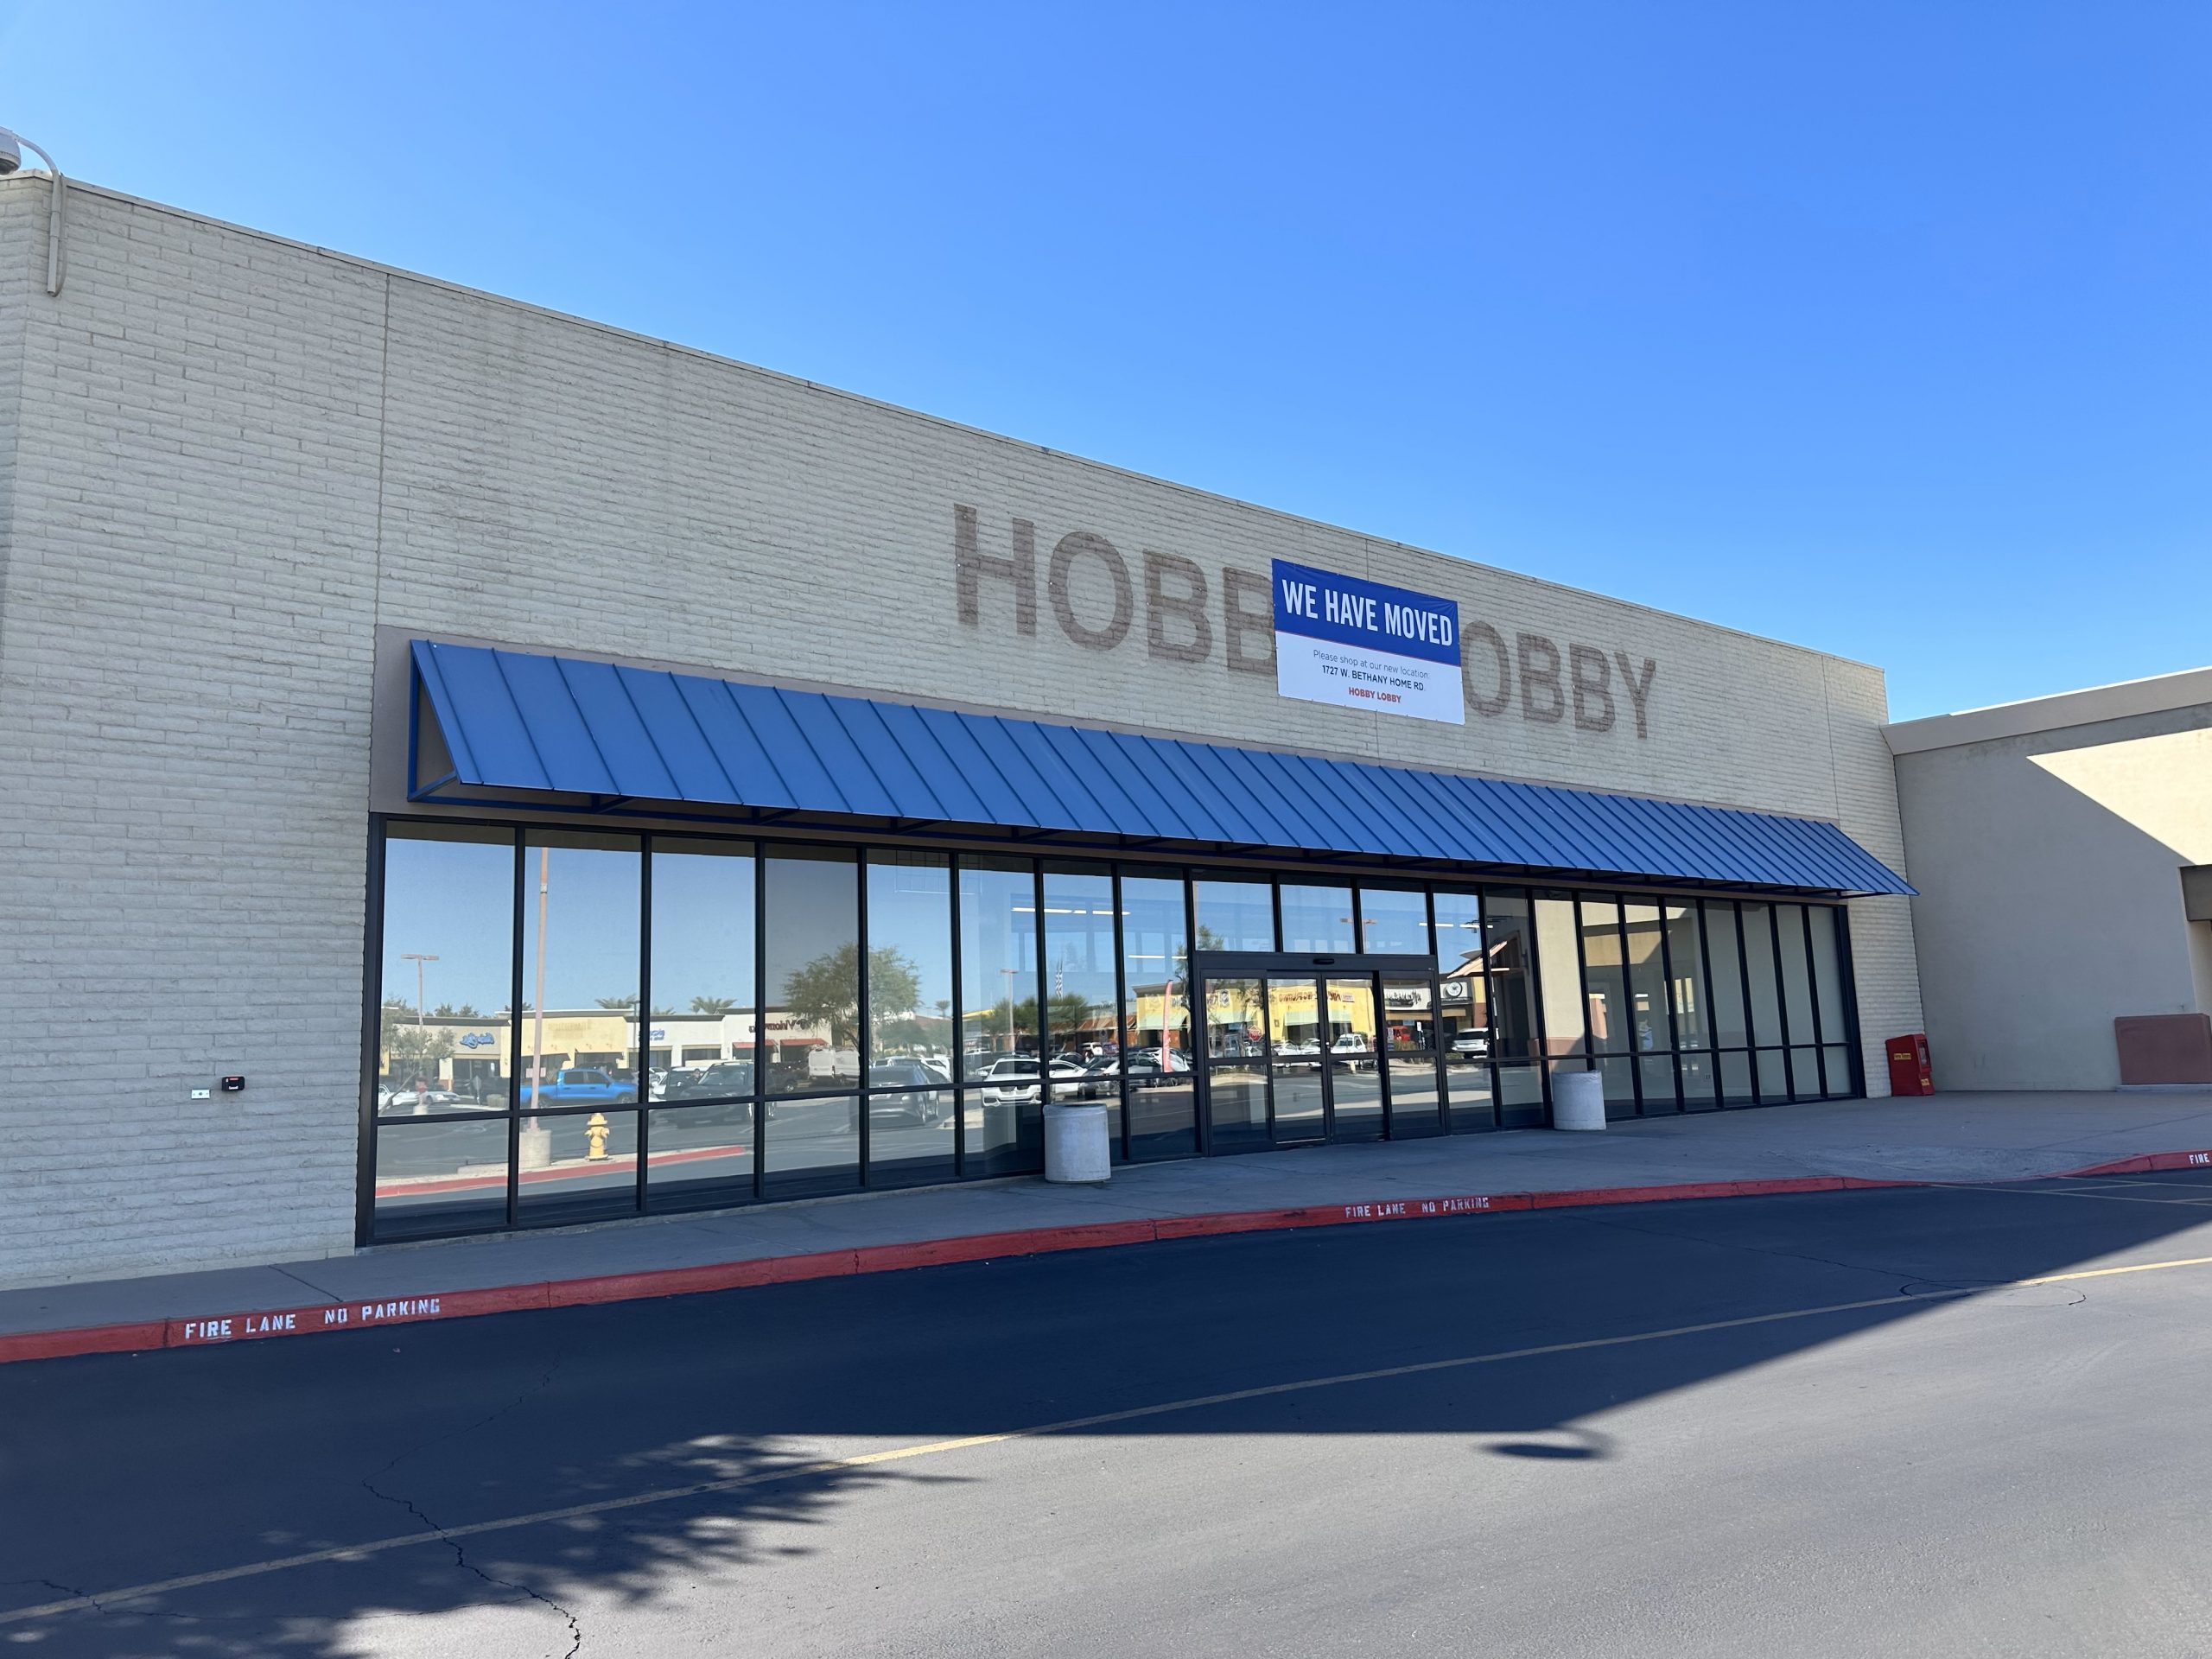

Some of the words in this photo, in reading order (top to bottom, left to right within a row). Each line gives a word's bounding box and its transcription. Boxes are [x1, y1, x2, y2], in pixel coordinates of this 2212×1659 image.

[954, 503, 1276, 675] HOBB
[1460, 620, 1656, 740] OBBY
[1281, 579, 1319, 620] WE
[1325, 588, 1378, 632] HAVE
[1384, 602, 1452, 646] MOVED
[1313, 650, 1338, 663] Please
[1339, 656, 1358, 667] shop
[1360, 659, 1368, 669] at
[1369, 662, 1382, 671] our
[1383, 664, 1399, 674] new
[1322, 664, 1338, 676] 1727
[1340, 668, 1350, 678] W.
[1351, 670, 1388, 685] BETHANY
[1389, 677, 1412, 690] HOME
[1348, 686, 1376, 699] HOBBY
[1376, 691, 1402, 703] LOBBY
[2189, 1154, 2210, 1164] FIRE
[1345, 1205, 1371, 1218] FIRE
[1377, 1203, 1406, 1217] LANE
[1421, 1201, 1435, 1213] NO
[1442, 1197, 1489, 1211] PARKING
[185, 1319, 232, 1339] FIRE
[245, 1313, 296, 1333] LANE
[324, 1308, 347, 1325] NO
[361, 1298, 440, 1321] PARKING
